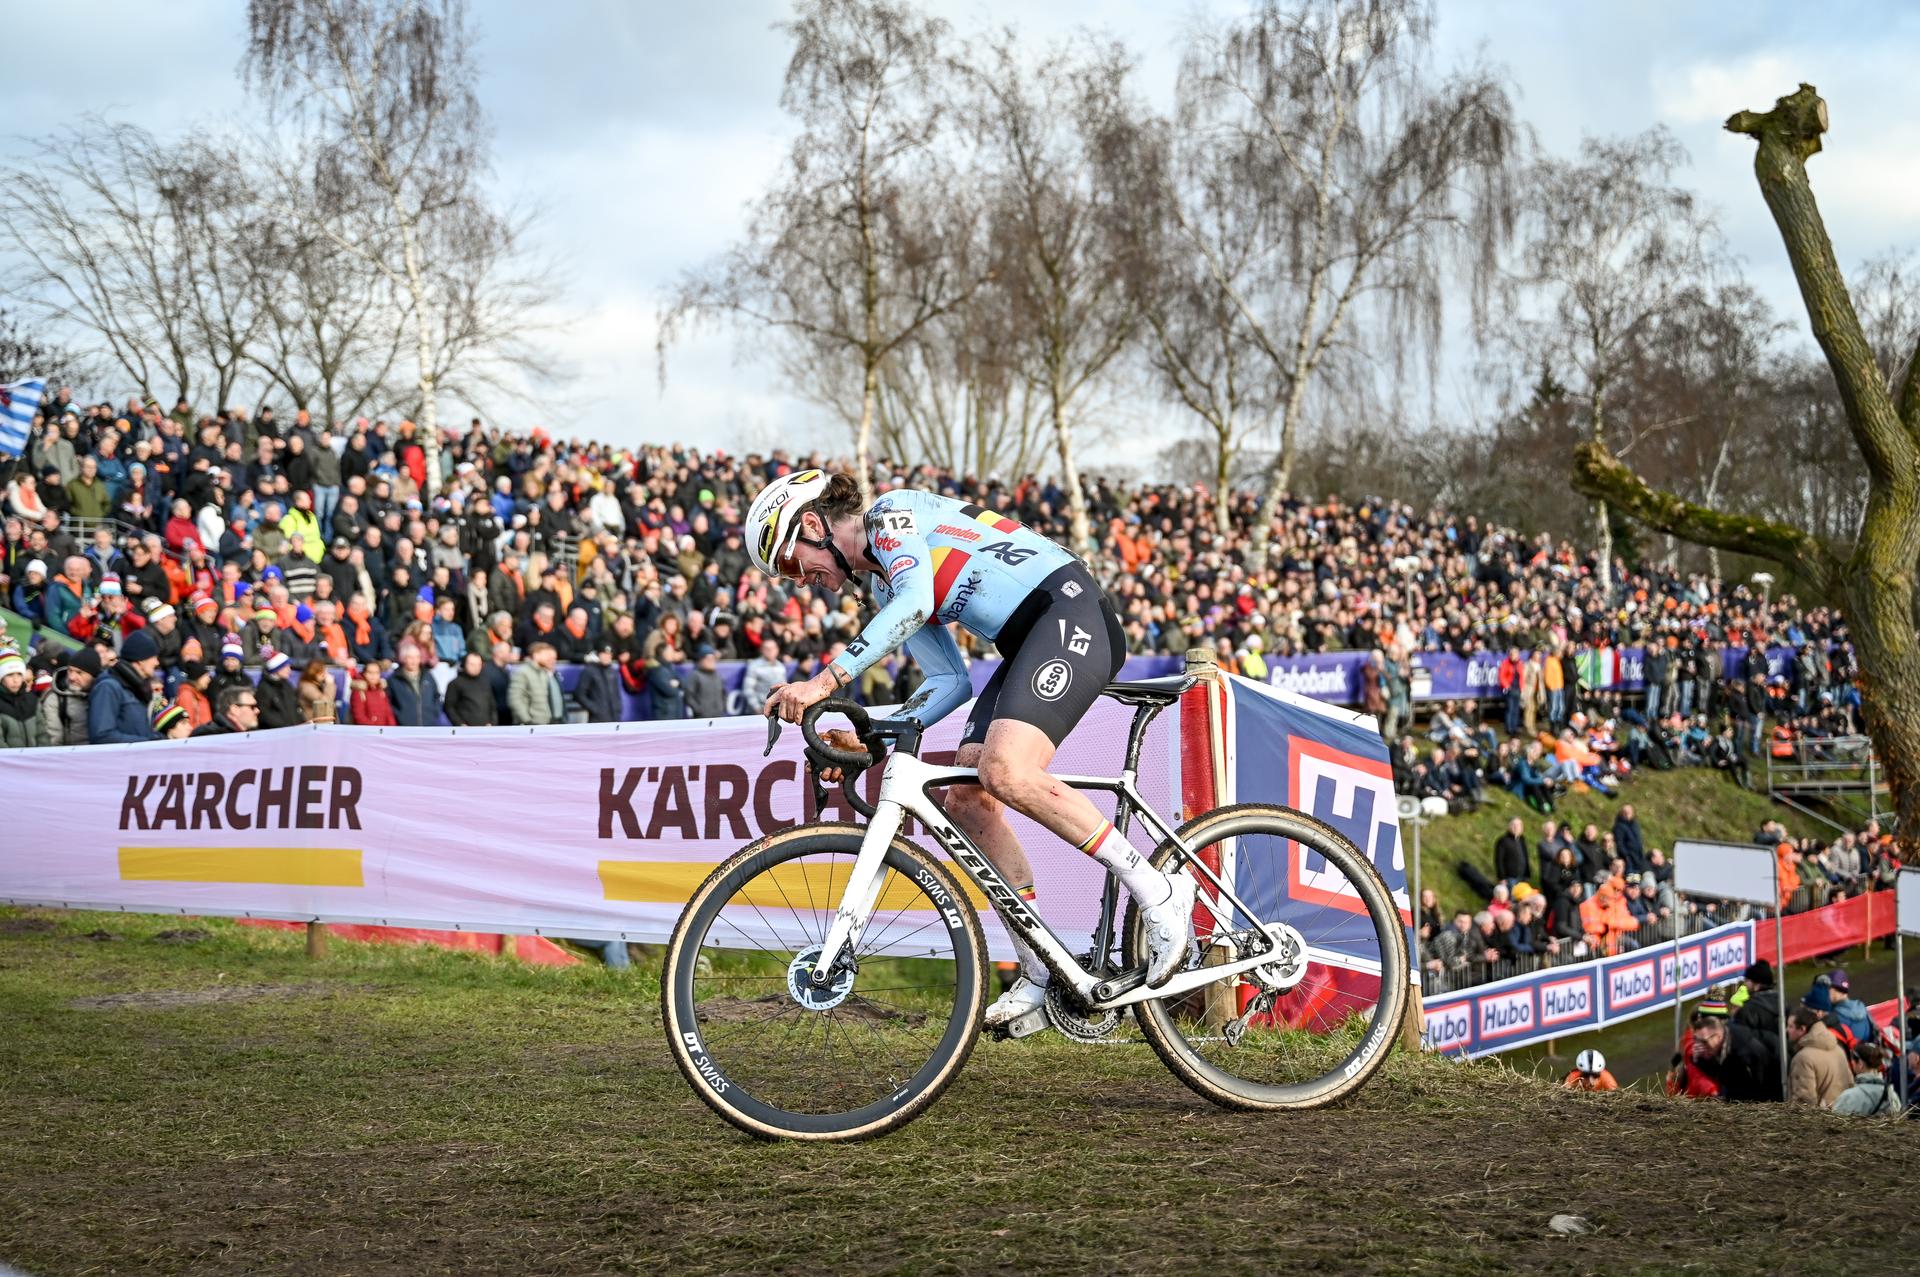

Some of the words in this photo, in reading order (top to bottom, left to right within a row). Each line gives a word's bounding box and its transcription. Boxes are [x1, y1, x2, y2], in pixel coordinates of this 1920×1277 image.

[888, 516, 913, 530] 12
[977, 541, 1039, 566] AG
[845, 633, 870, 658] EY
[1068, 625, 1092, 657] EY
[1270, 663, 1347, 693] Rabobank
[119, 765, 363, 830] KÄRCHER
[915, 869, 951, 905] SWISS
[933, 825, 1041, 929] STEVENS
[942, 907, 964, 929] DT
[1663, 957, 1698, 986] Hbo
[1709, 944, 1743, 970] Hubo
[1613, 969, 1651, 999] Hubo
[1484, 999, 1530, 1031] Hubo
[1544, 986, 1587, 1017] Hubo
[1361, 1022, 1387, 1058] SWISS
[683, 1031, 704, 1053] DT
[694, 1056, 730, 1093] SWISS
